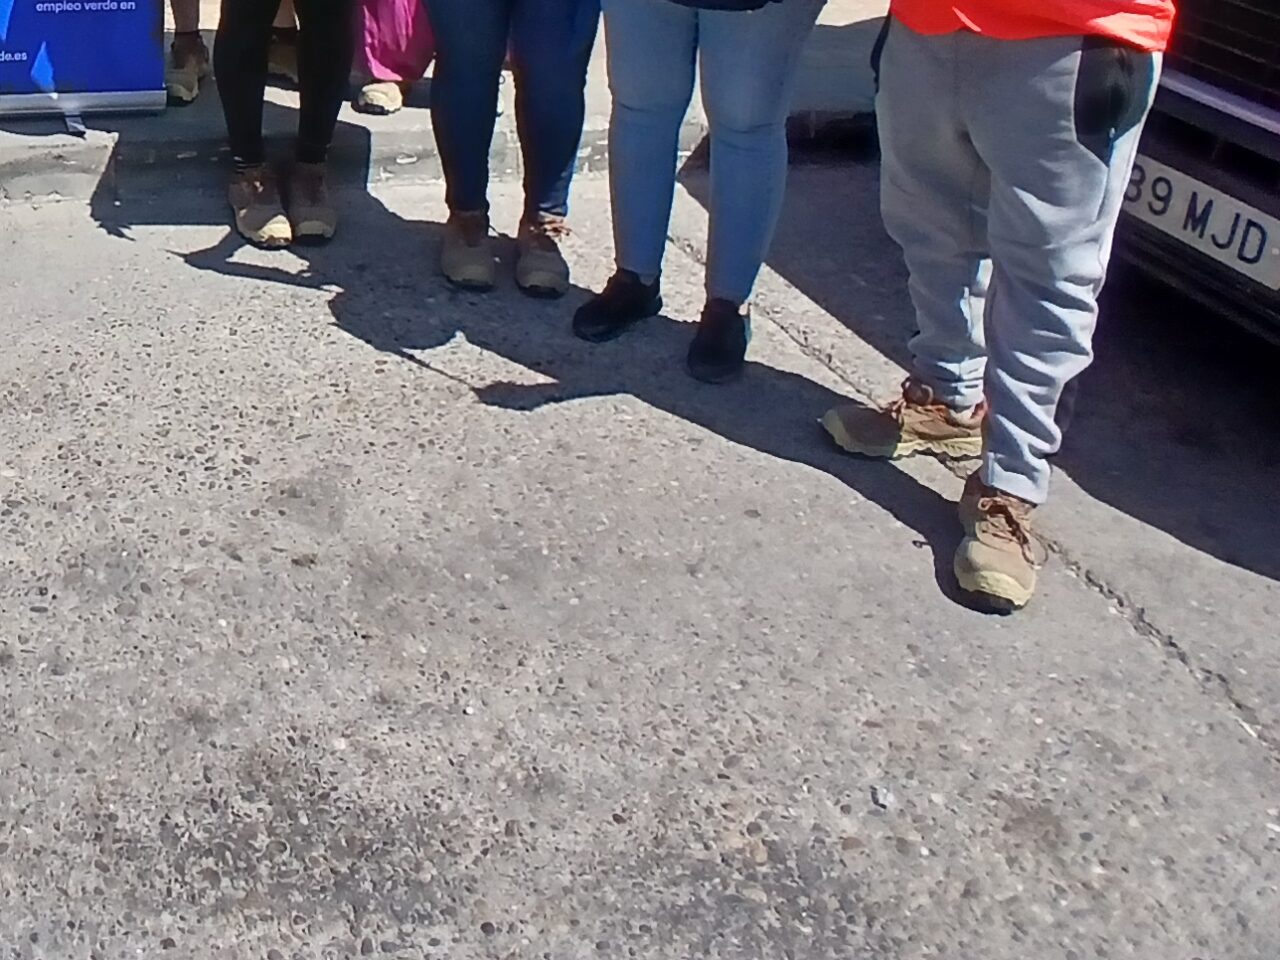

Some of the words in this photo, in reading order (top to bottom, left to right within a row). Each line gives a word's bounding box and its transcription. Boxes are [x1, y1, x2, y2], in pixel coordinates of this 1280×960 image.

[36, 0, 82, 14] empleo
[84, 0, 118, 10] verde
[120, 1, 136, 10] en
[1182, 191, 1268, 264] MJD
